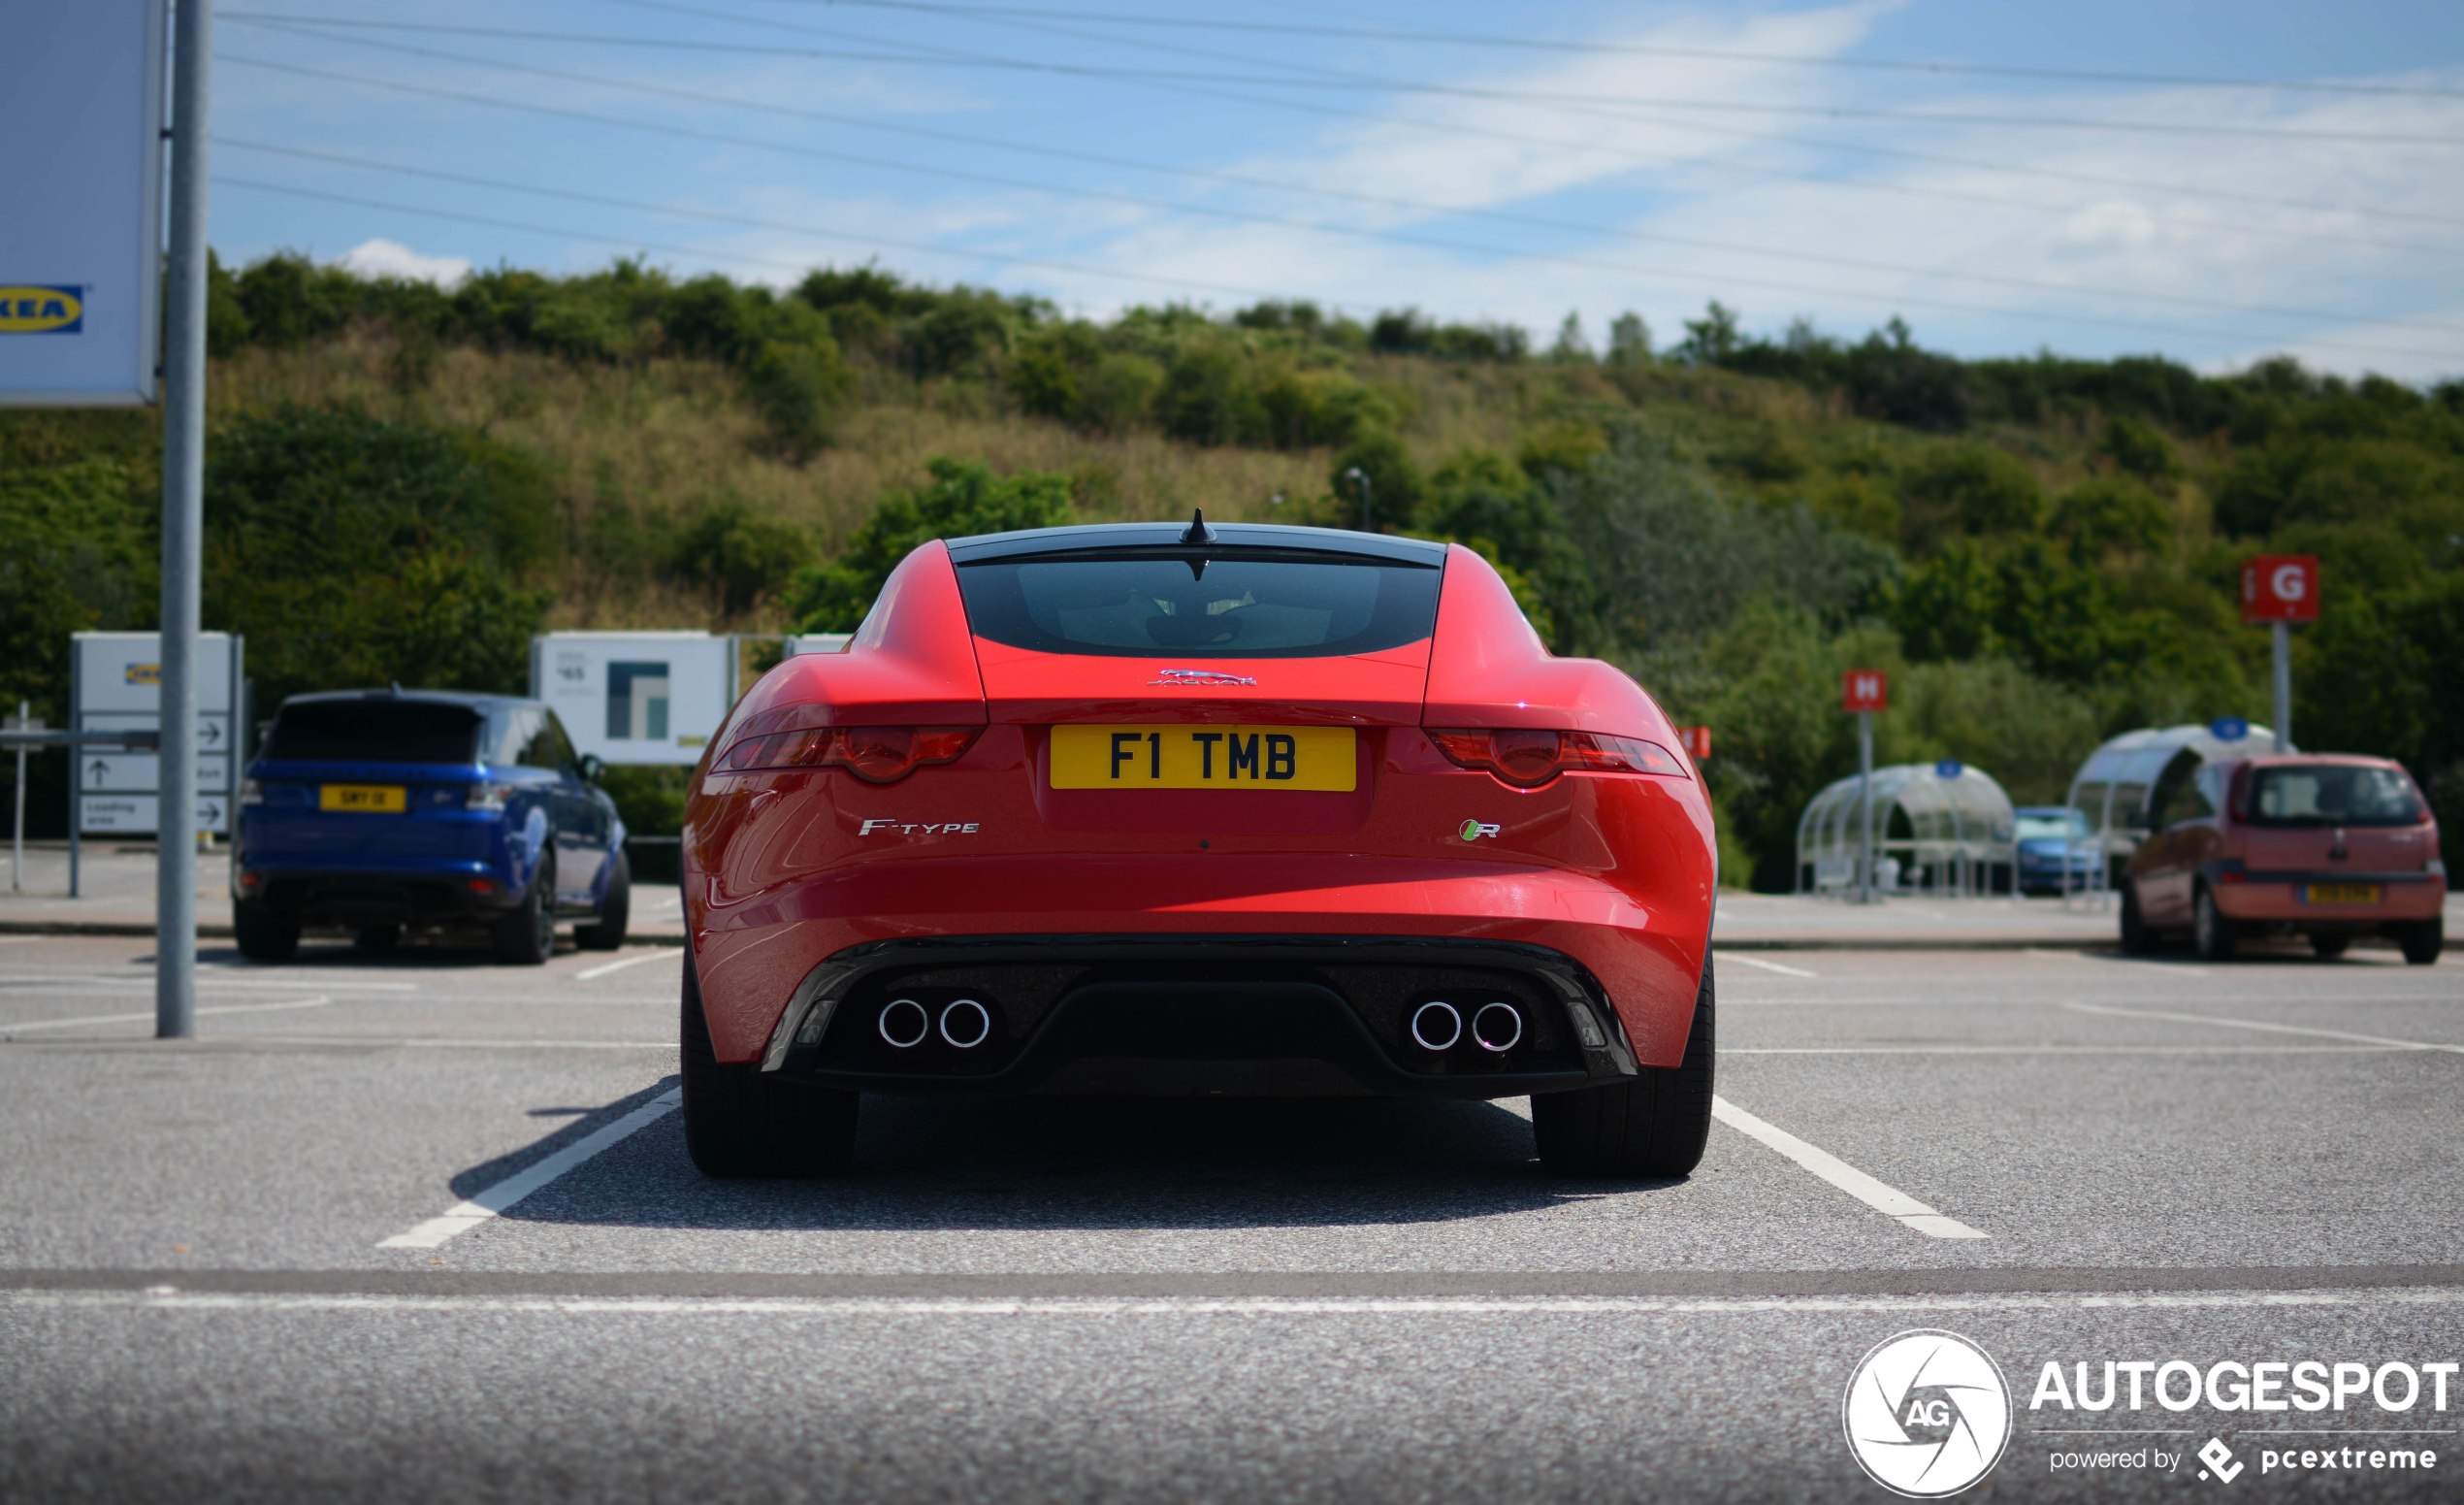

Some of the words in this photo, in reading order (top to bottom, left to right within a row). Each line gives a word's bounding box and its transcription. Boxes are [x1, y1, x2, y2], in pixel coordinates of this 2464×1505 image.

[2271, 564, 2305, 601] G
[1855, 675, 1879, 700] H
[1111, 733, 1160, 779] F1
[1192, 733, 1296, 780] TMB
[859, 819, 980, 836] F-TYPE
